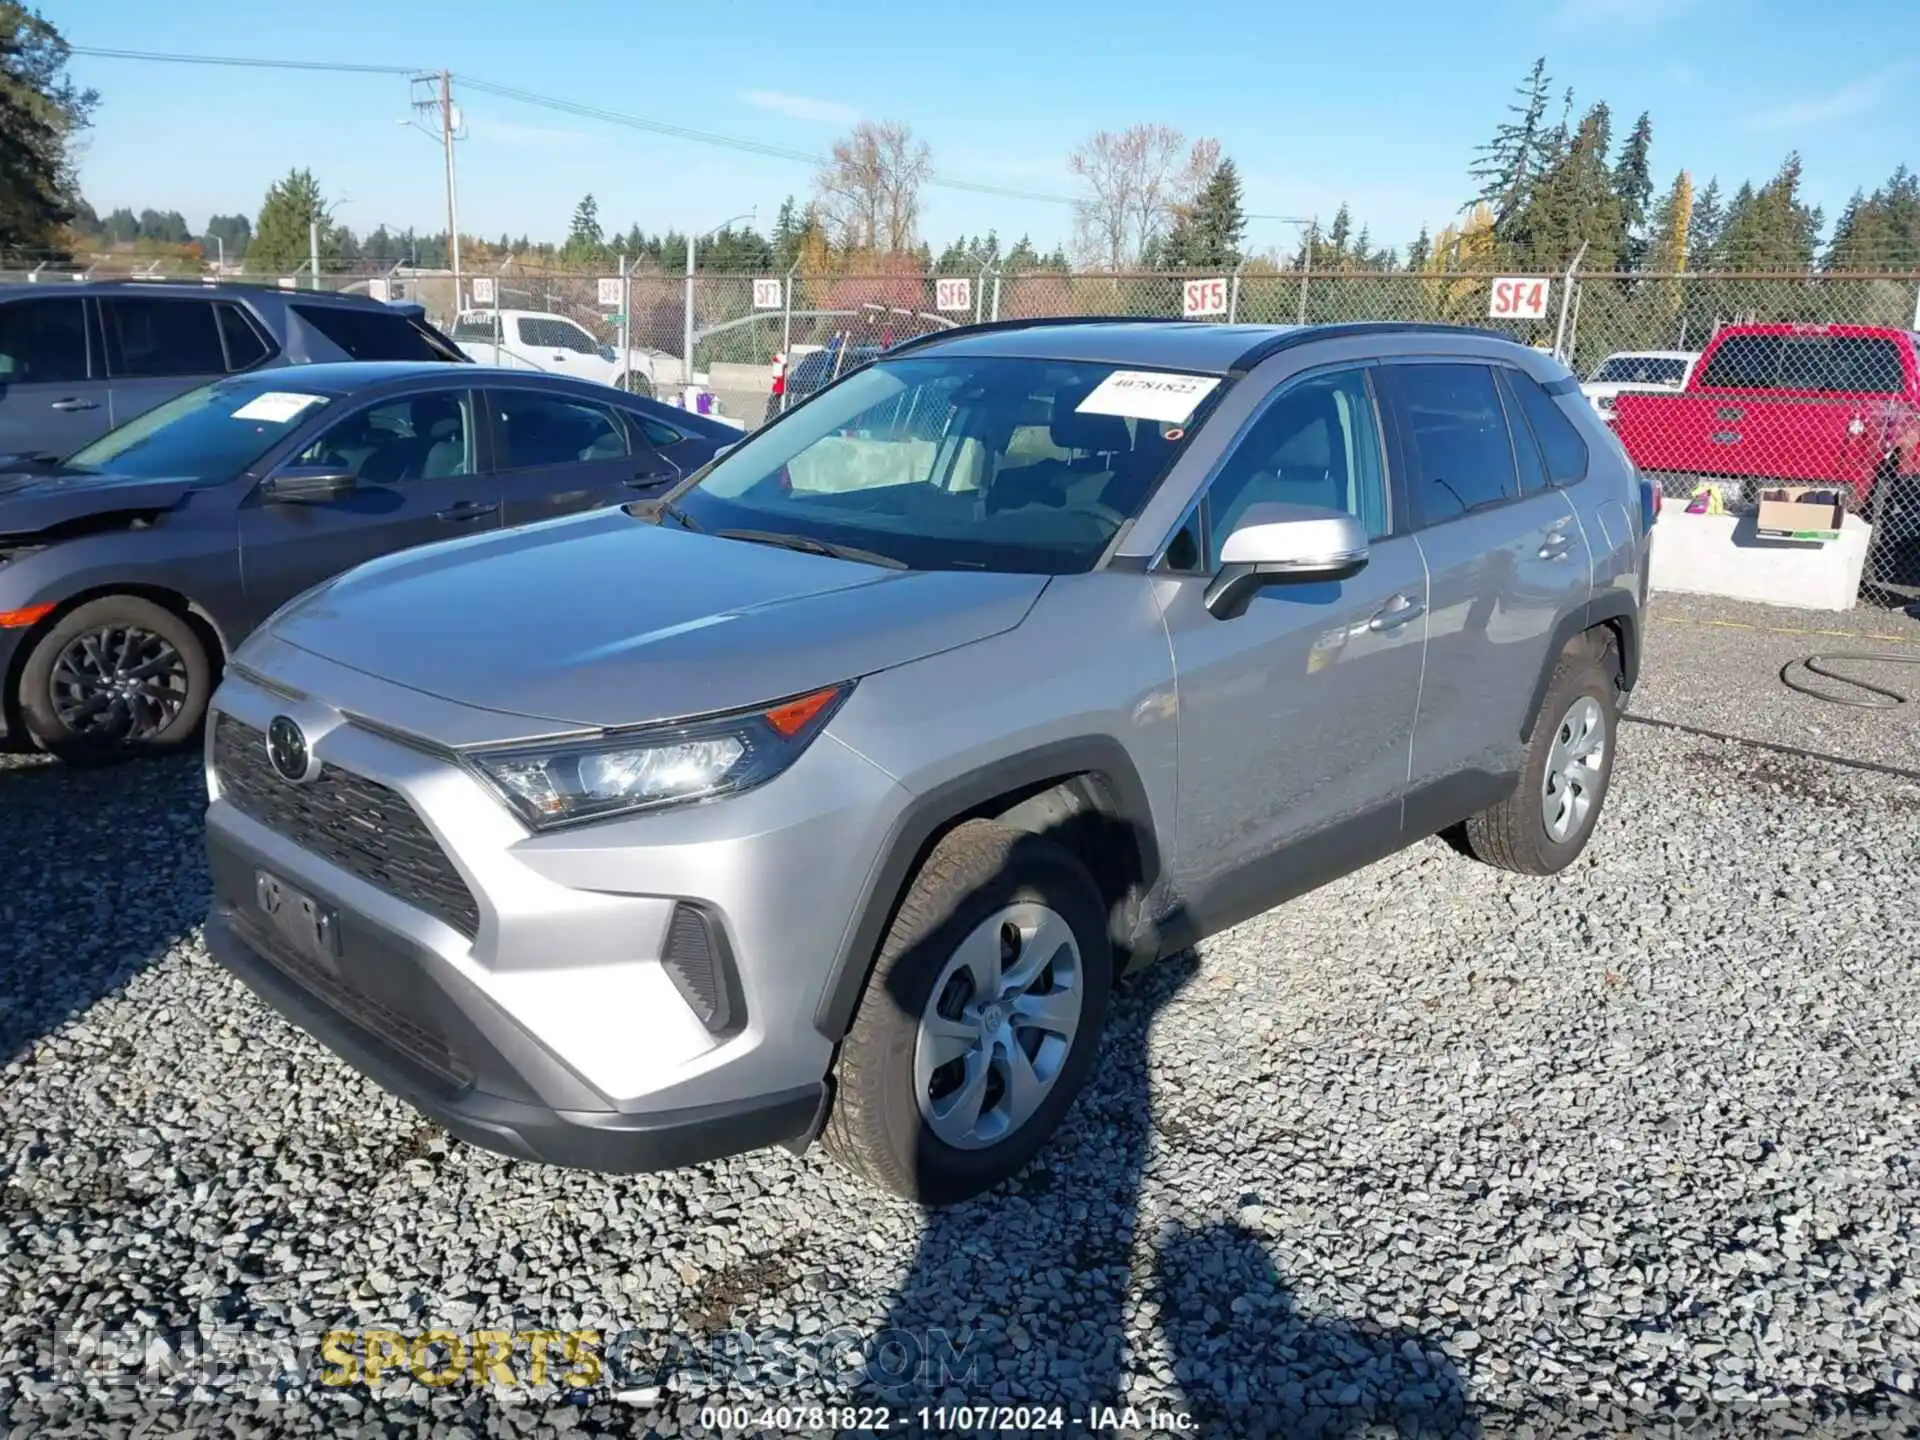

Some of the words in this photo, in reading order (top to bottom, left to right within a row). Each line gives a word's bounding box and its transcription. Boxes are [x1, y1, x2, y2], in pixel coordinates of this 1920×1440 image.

[755, 282, 778, 304] SF7
[939, 282, 968, 306] SF6
[1187, 283, 1222, 311] SF5
[1495, 282, 1543, 313] SF4
[1112, 378, 1197, 394] 40781822
